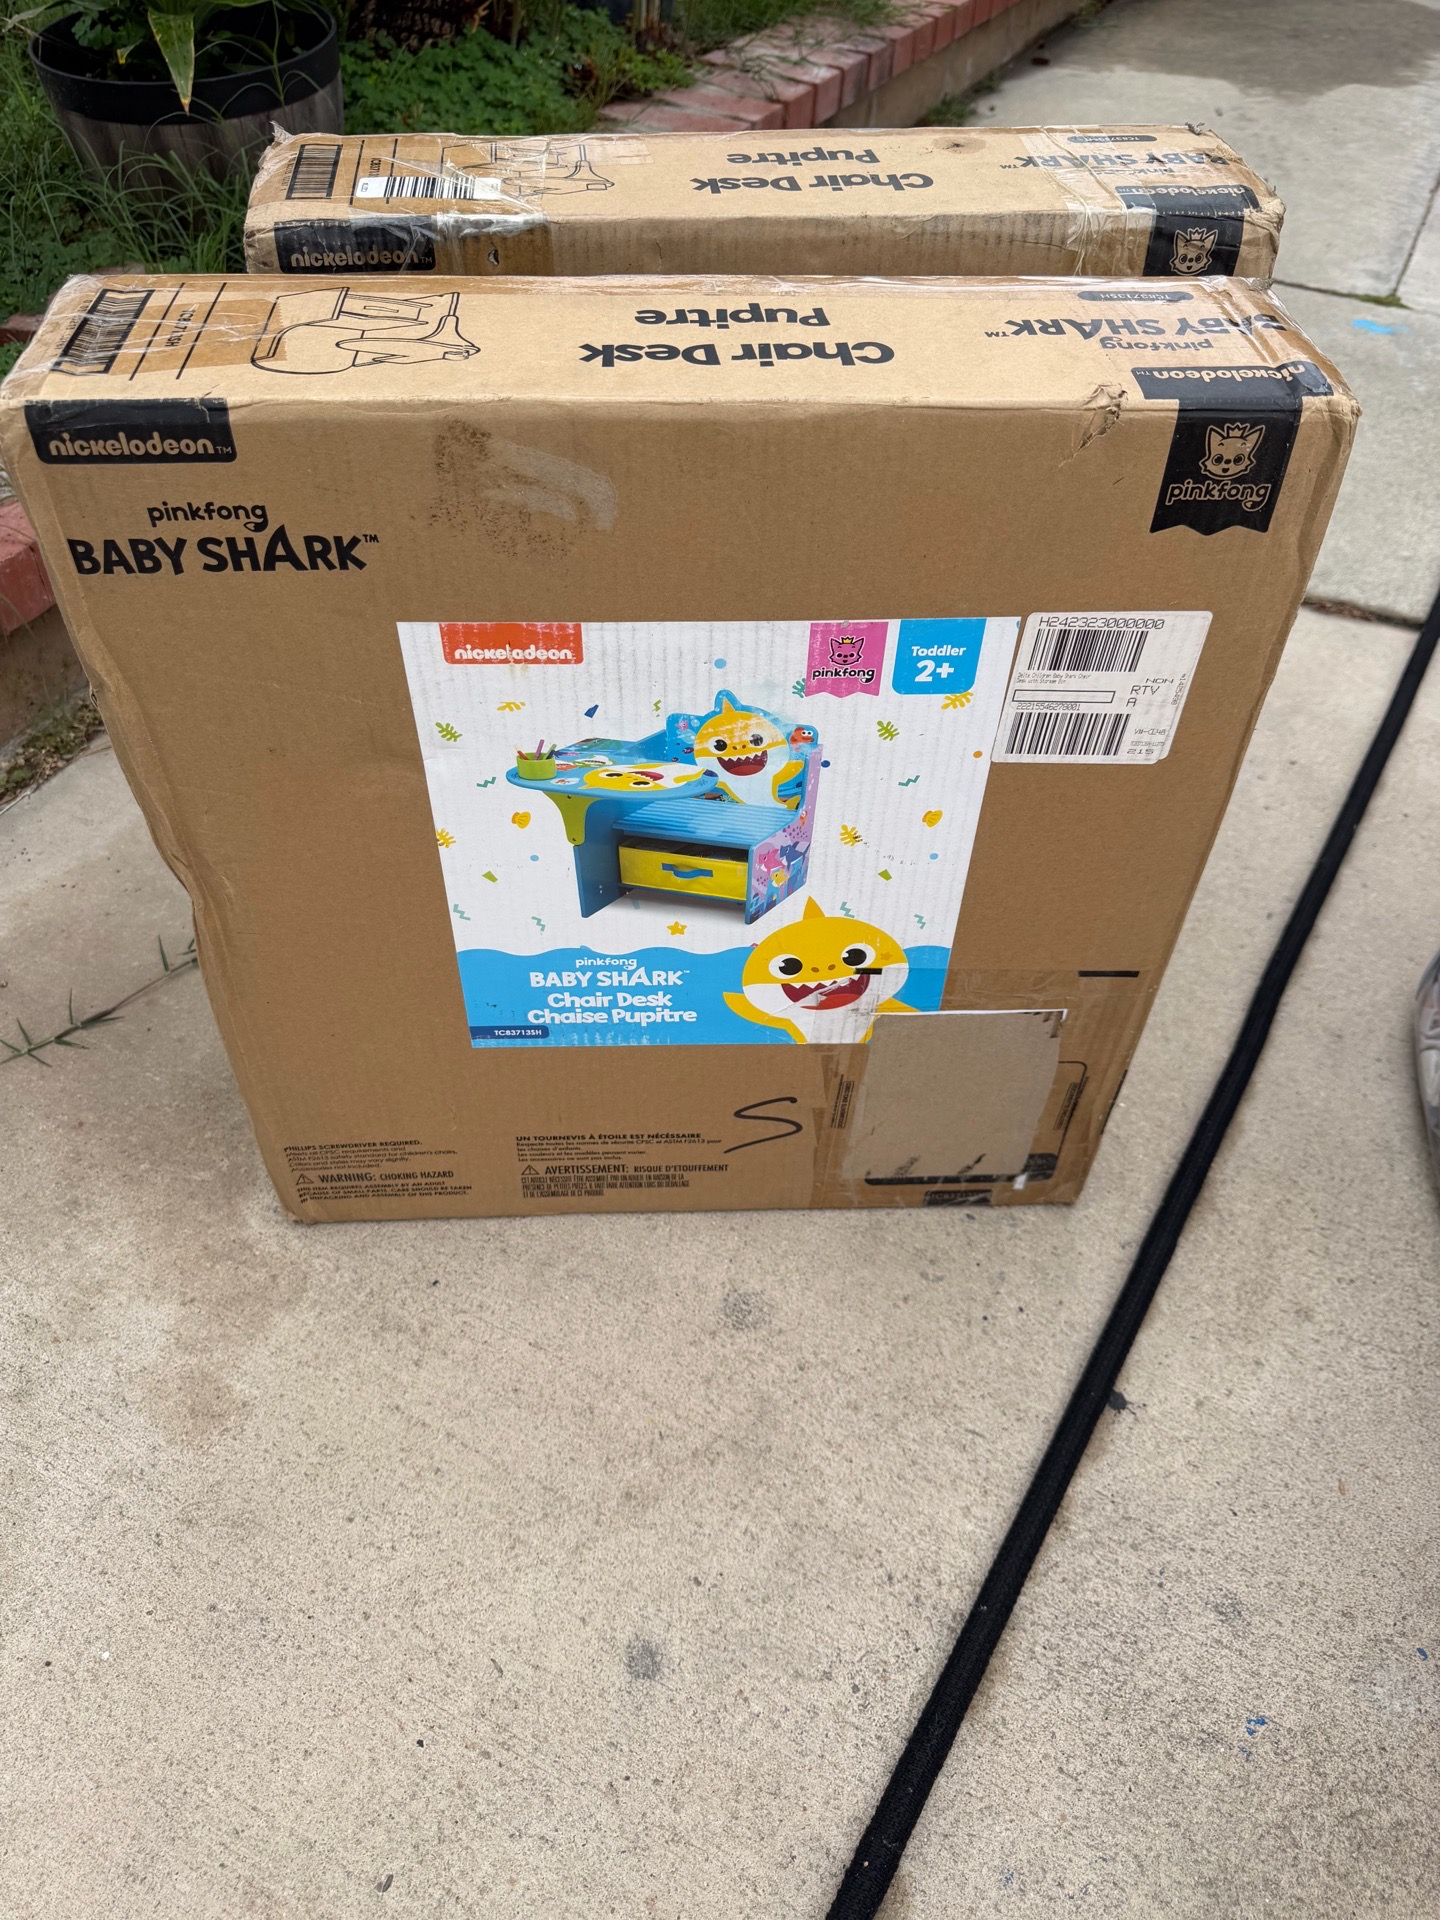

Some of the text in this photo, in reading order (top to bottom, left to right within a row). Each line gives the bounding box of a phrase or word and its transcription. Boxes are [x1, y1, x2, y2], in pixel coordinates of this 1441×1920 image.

[726, 146, 881, 167] Pupitre
[1014, 152, 1134, 168] SHARK
[689, 171, 934, 195] Chair Desk
[291, 247, 420, 267] nickelodeon
[635, 303, 831, 330] Pupitre
[1004, 318, 1165, 340] SHARK
[1100, 337, 1215, 351] pinkfong
[578, 341, 895, 368] Chair Desk
[1152, 364, 1306, 382] nickelodeon
[48, 431, 215, 457] nickelodeon
[1165, 479, 1272, 512] pinkfong
[147, 501, 269, 533] pinkfong
[66, 536, 188, 576] BABY
[197, 524, 368, 572] SHARK
[911, 645, 967, 657] Toddler
[812, 667, 876, 684] pinkfong
[914, 659, 955, 682] 2+
[1130, 685, 1160, 695] RTV
[1126, 697, 1137, 707] A
[575, 957, 638, 970] pinkfong
[529, 970, 593, 988] BABY
[597, 966, 684, 987] SHARK
[547, 991, 673, 1008] Chair Desk
[527, 1008, 697, 1027] Chaise Pupitre
[318, 1142, 377, 1150] SCREWDRIVER
[318, 1170, 454, 1183] WARNING: CHOKING HAZARD
[544, 1163, 629, 1175] AVERTISSEMENT:
[634, 1164, 663, 1173] RISQUE
